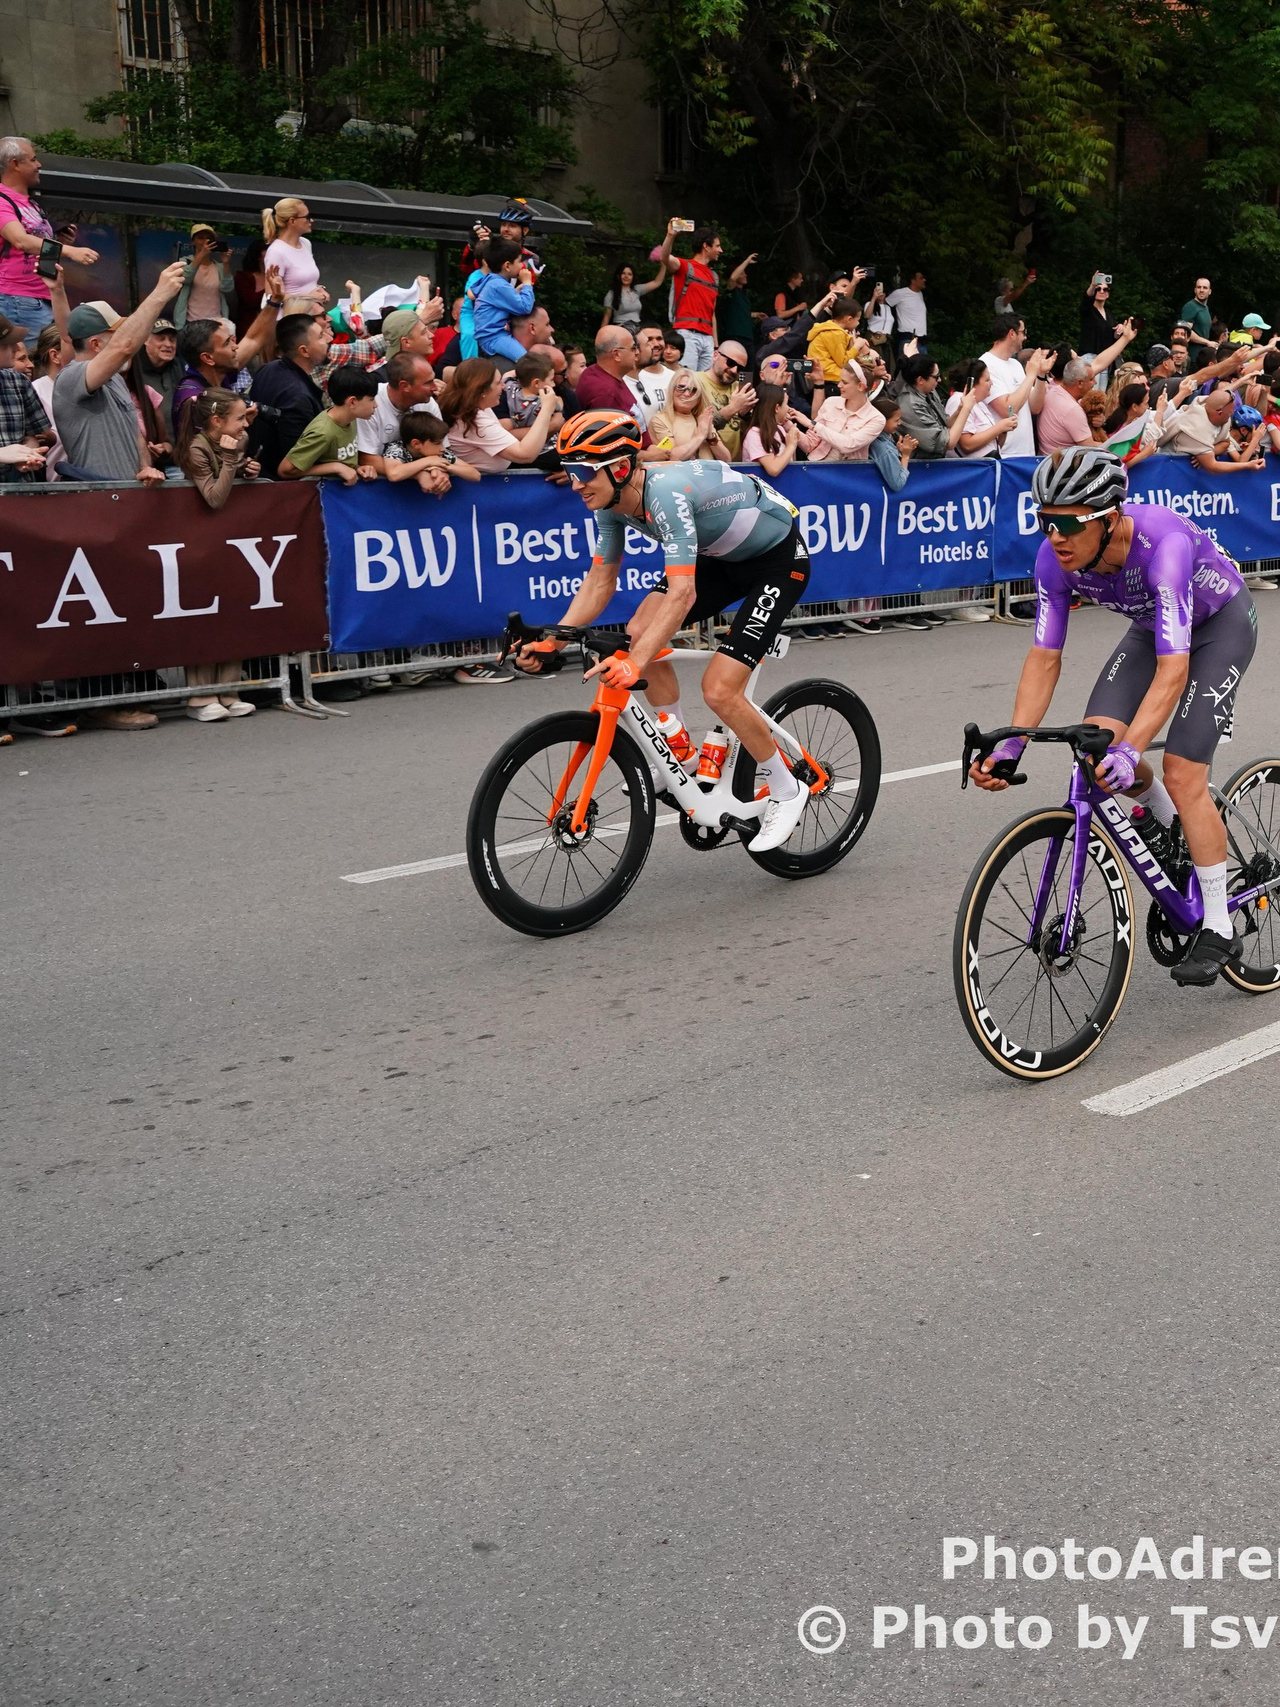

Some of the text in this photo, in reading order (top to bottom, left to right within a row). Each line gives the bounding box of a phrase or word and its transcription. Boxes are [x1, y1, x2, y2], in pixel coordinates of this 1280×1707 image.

[1086, 468, 1111, 495] GIANT
[649, 497, 674, 542] INEOS
[671, 490, 696, 537] wtw
[799, 501, 871, 555] BW
[897, 500, 959, 536] Best
[353, 525, 457, 592] BW
[494, 522, 579, 566] Best
[920, 540, 989, 564] Hotels &
[0, 534, 298, 629] ALY
[1192, 564, 1231, 595] Jayco
[742, 584, 781, 641] INEOS
[1035, 578, 1050, 642] GIANT
[1107, 652, 1127, 682] CADEX
[1181, 679, 1198, 719] CADEX
[630, 705, 688, 787] DOGMA
[634, 766, 649, 815] SCOPE
[1099, 797, 1179, 893] GIANT
[1067, 889, 1081, 938] GIANT
[968, 939, 1043, 1069] CADEX
